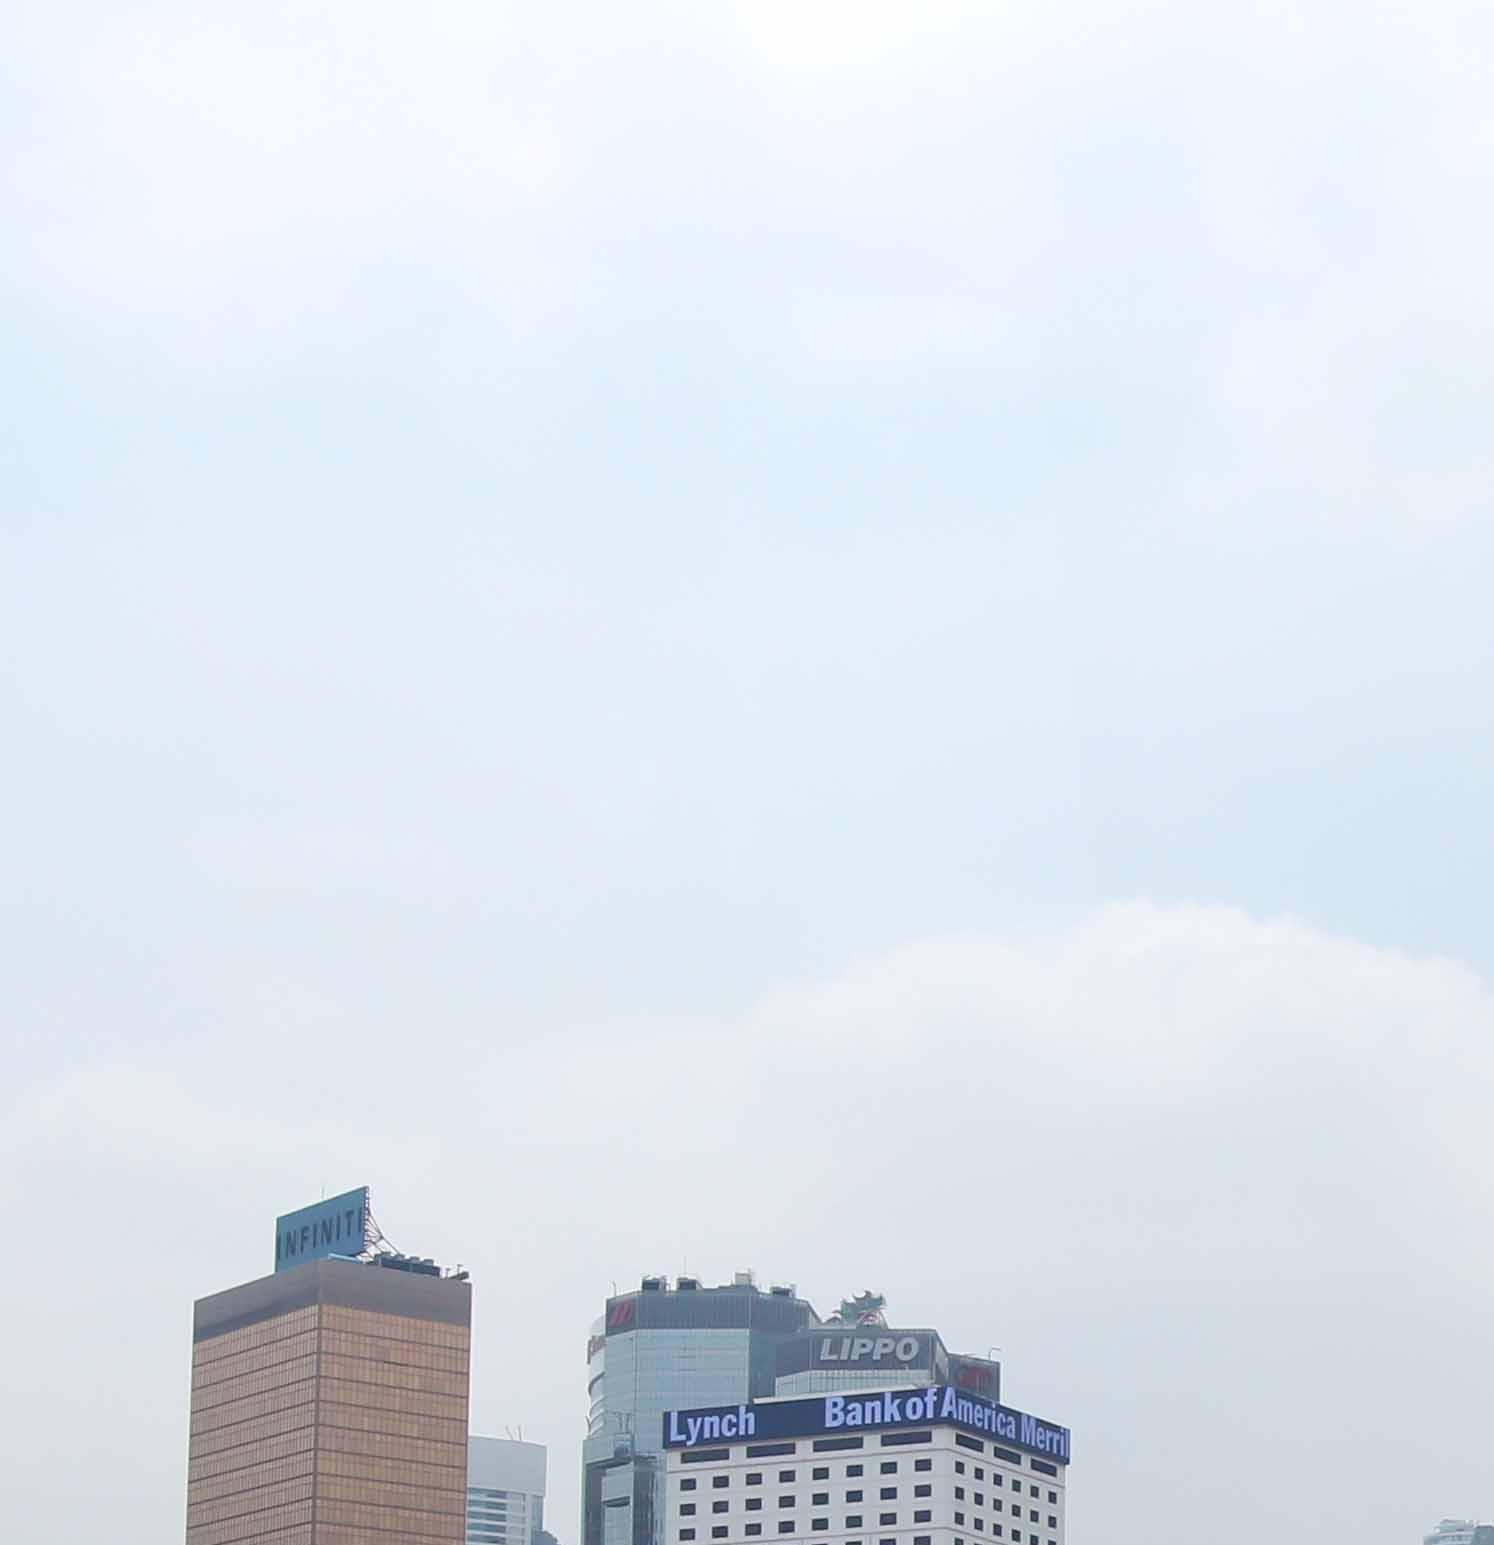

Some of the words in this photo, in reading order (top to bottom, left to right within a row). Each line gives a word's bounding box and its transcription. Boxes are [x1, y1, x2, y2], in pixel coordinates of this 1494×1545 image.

[277, 1207, 363, 1260] INFINITI
[820, 1337, 919, 1361] LIPPO
[668, 1406, 755, 1446] Lynch
[825, 1392, 900, 1427] Bank
[905, 1385, 938, 1419] of
[941, 1385, 1016, 1439] America
